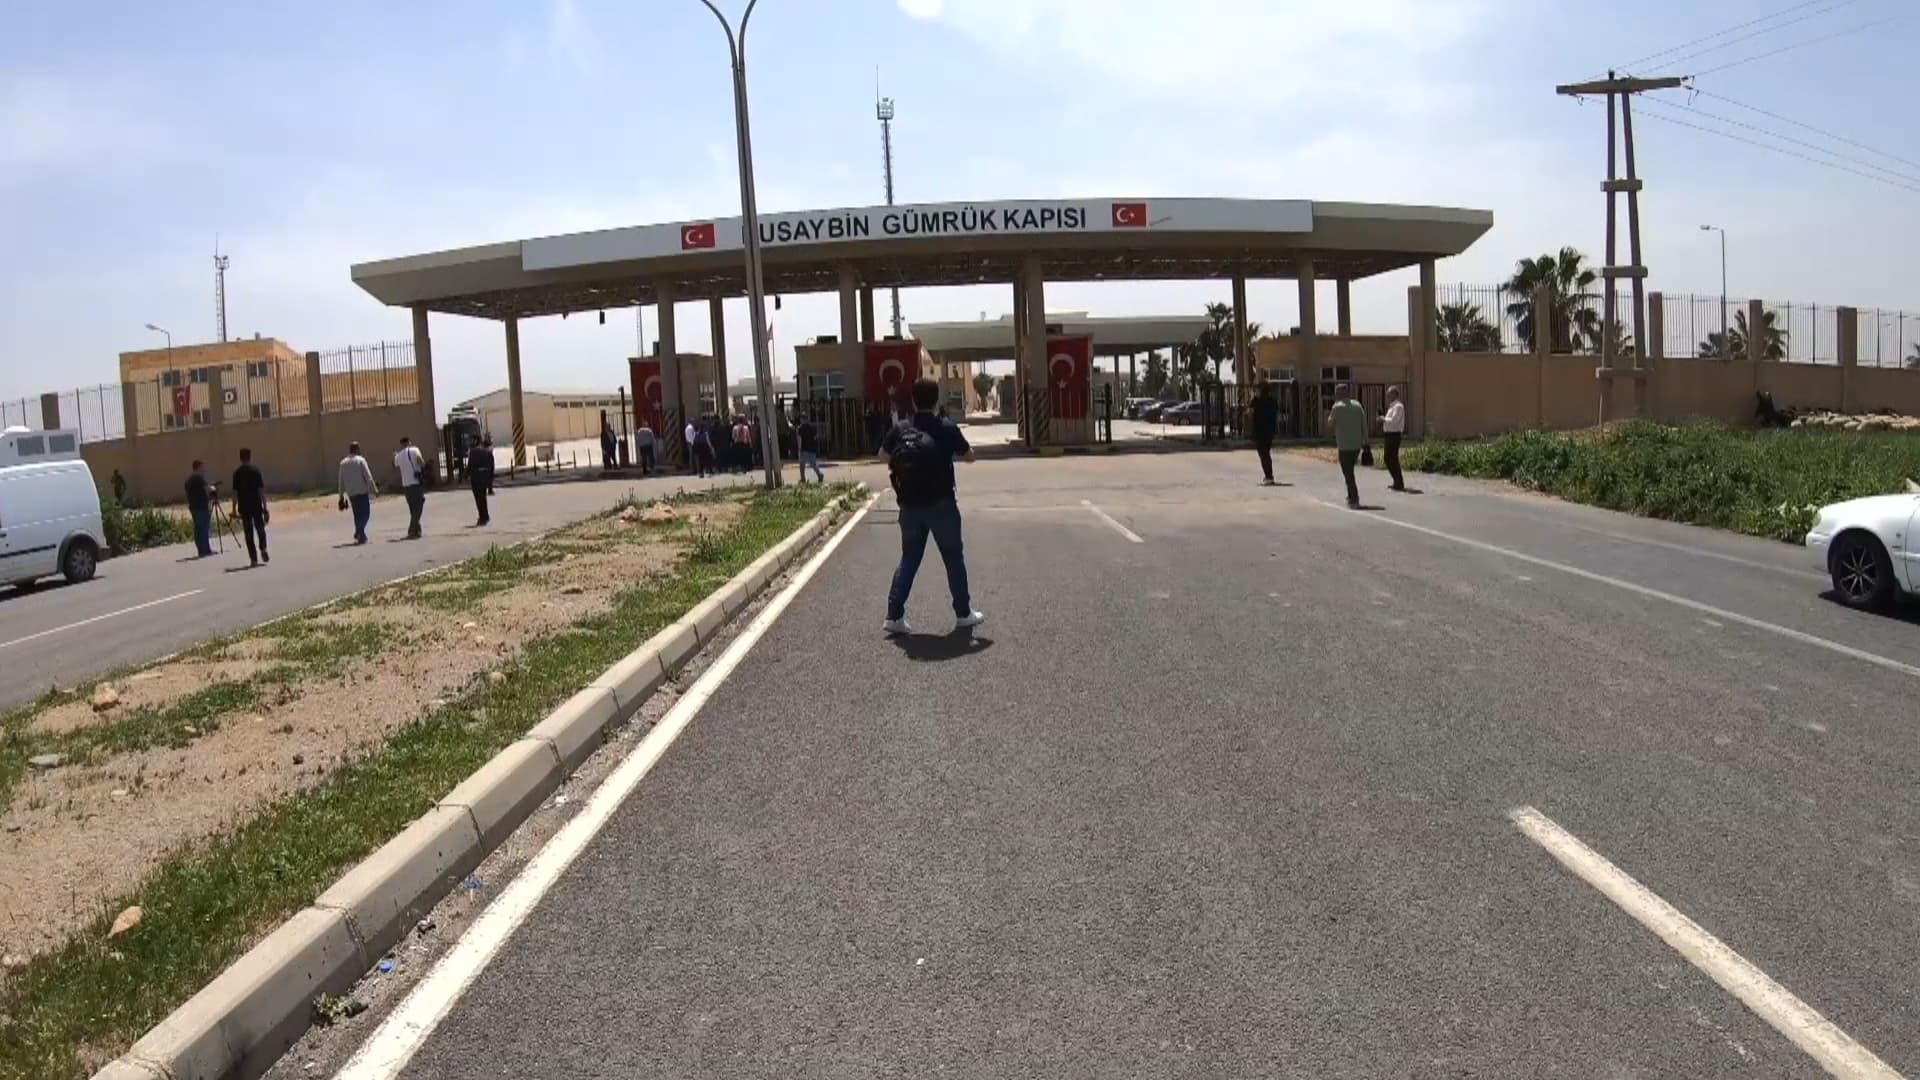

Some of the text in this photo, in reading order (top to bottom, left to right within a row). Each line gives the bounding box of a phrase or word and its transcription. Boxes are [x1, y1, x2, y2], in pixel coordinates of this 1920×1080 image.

[742, 206, 1086, 244] USAYBİN GÜMRÜK KAPISI
